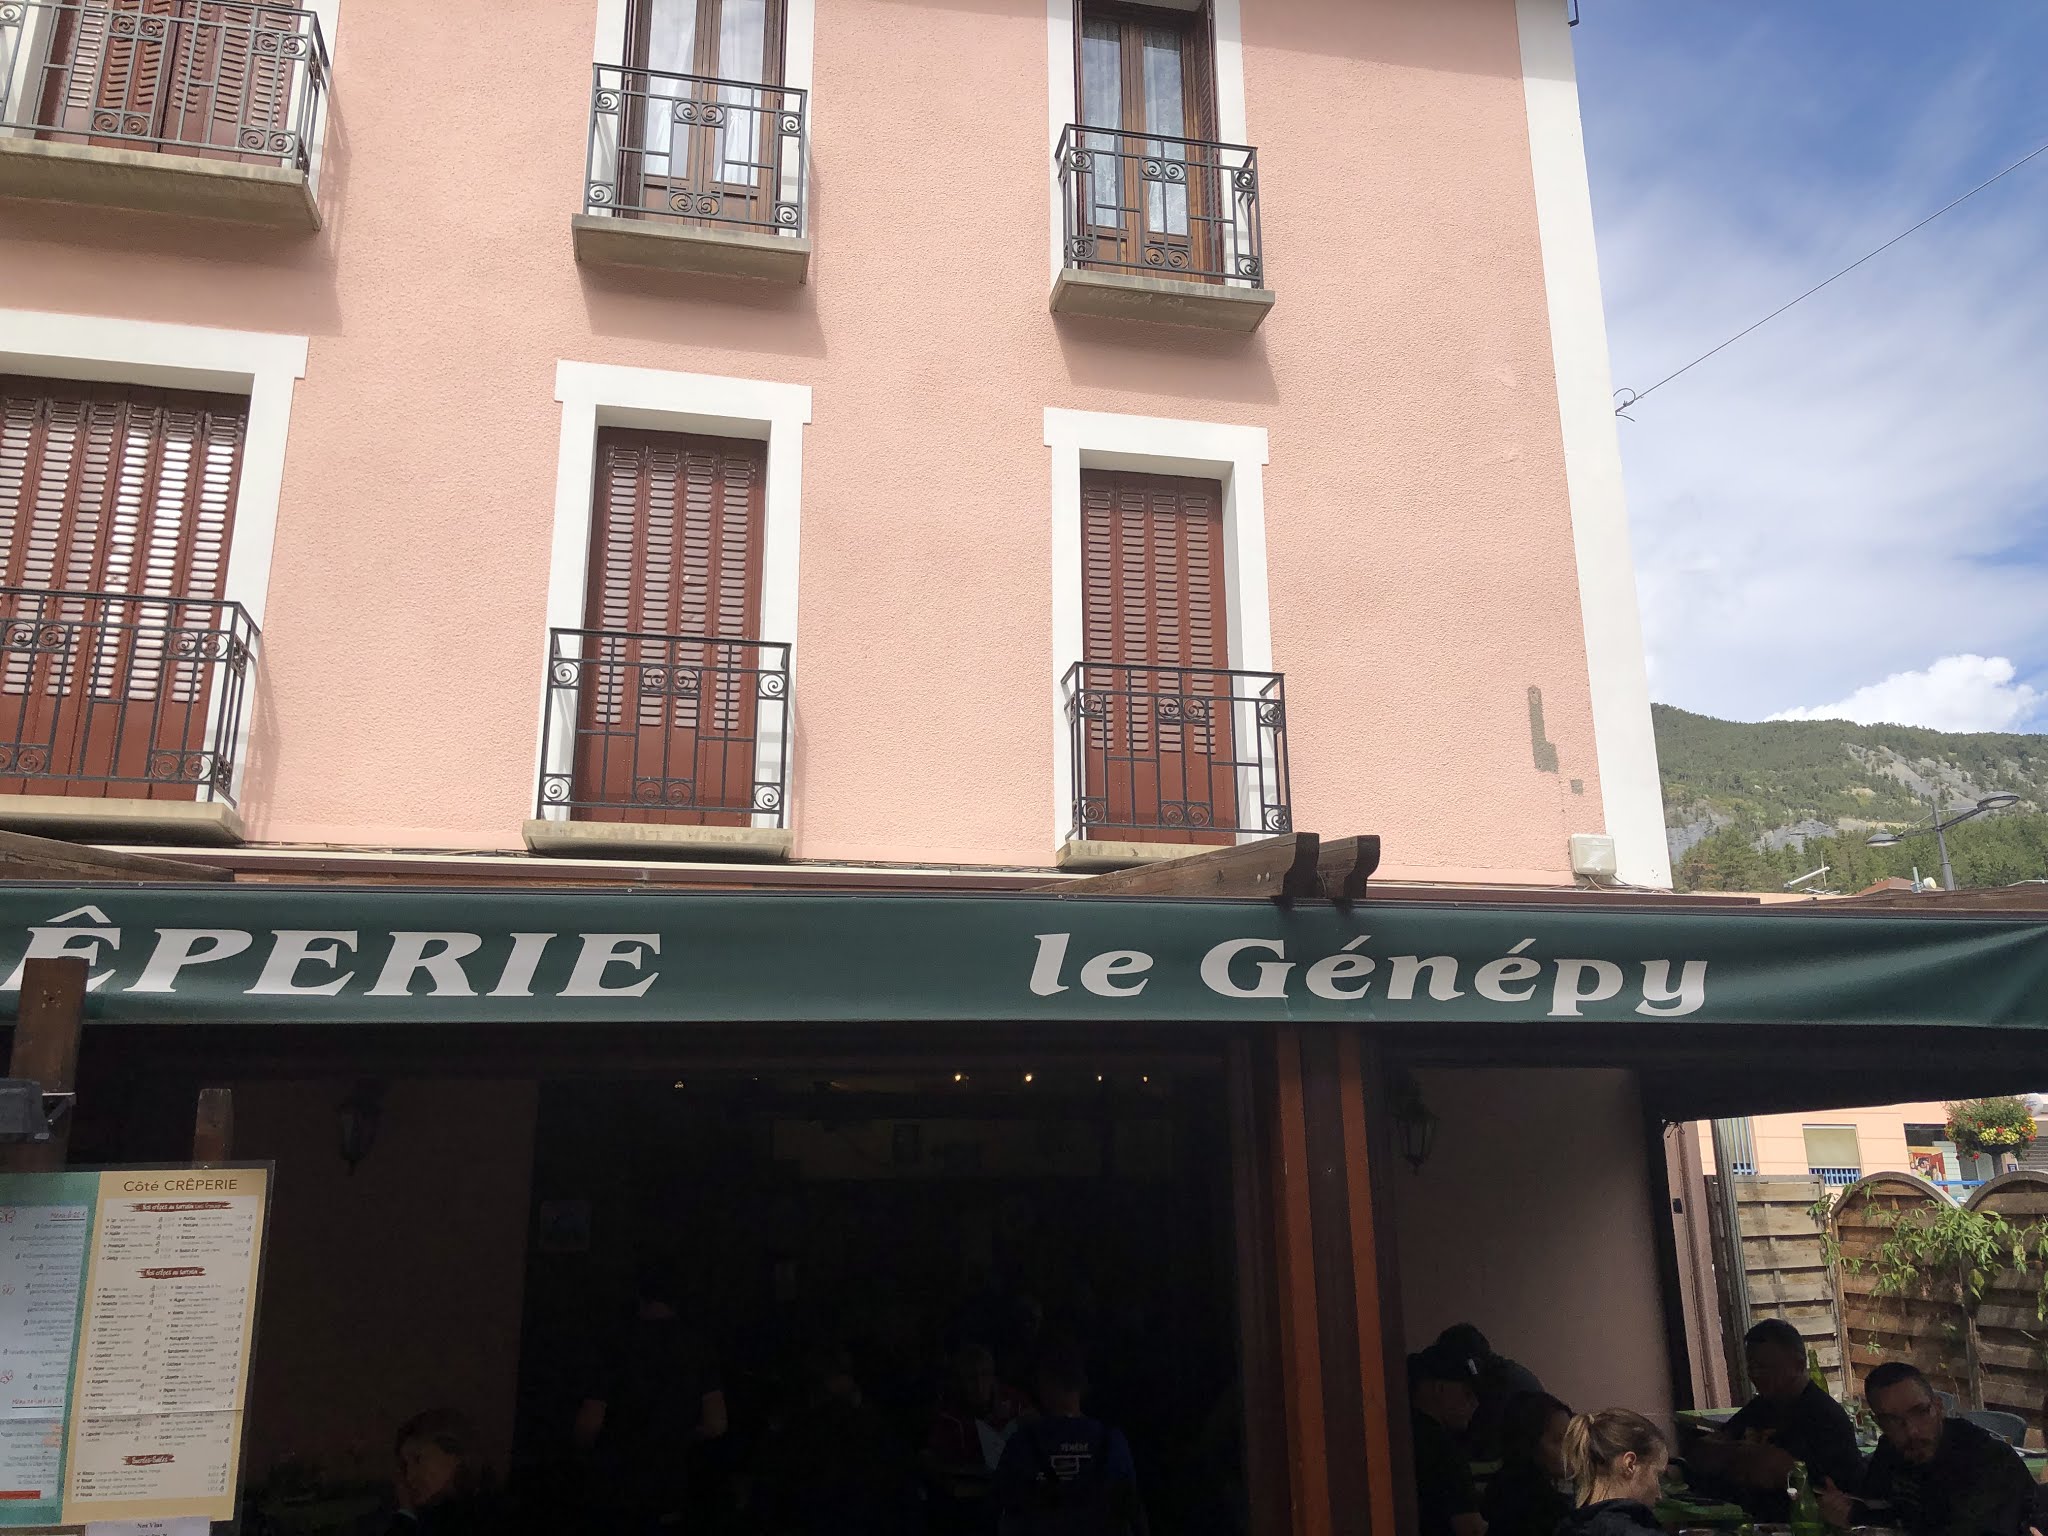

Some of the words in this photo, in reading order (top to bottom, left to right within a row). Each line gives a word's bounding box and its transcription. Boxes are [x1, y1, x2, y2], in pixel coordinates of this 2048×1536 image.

[1028, 933, 1154, 997] le
[1200, 935, 1709, 1017] Génépy
[123, 1180, 159, 1192] Côté
[164, 1178, 238, 1191] CRÊPERIE
